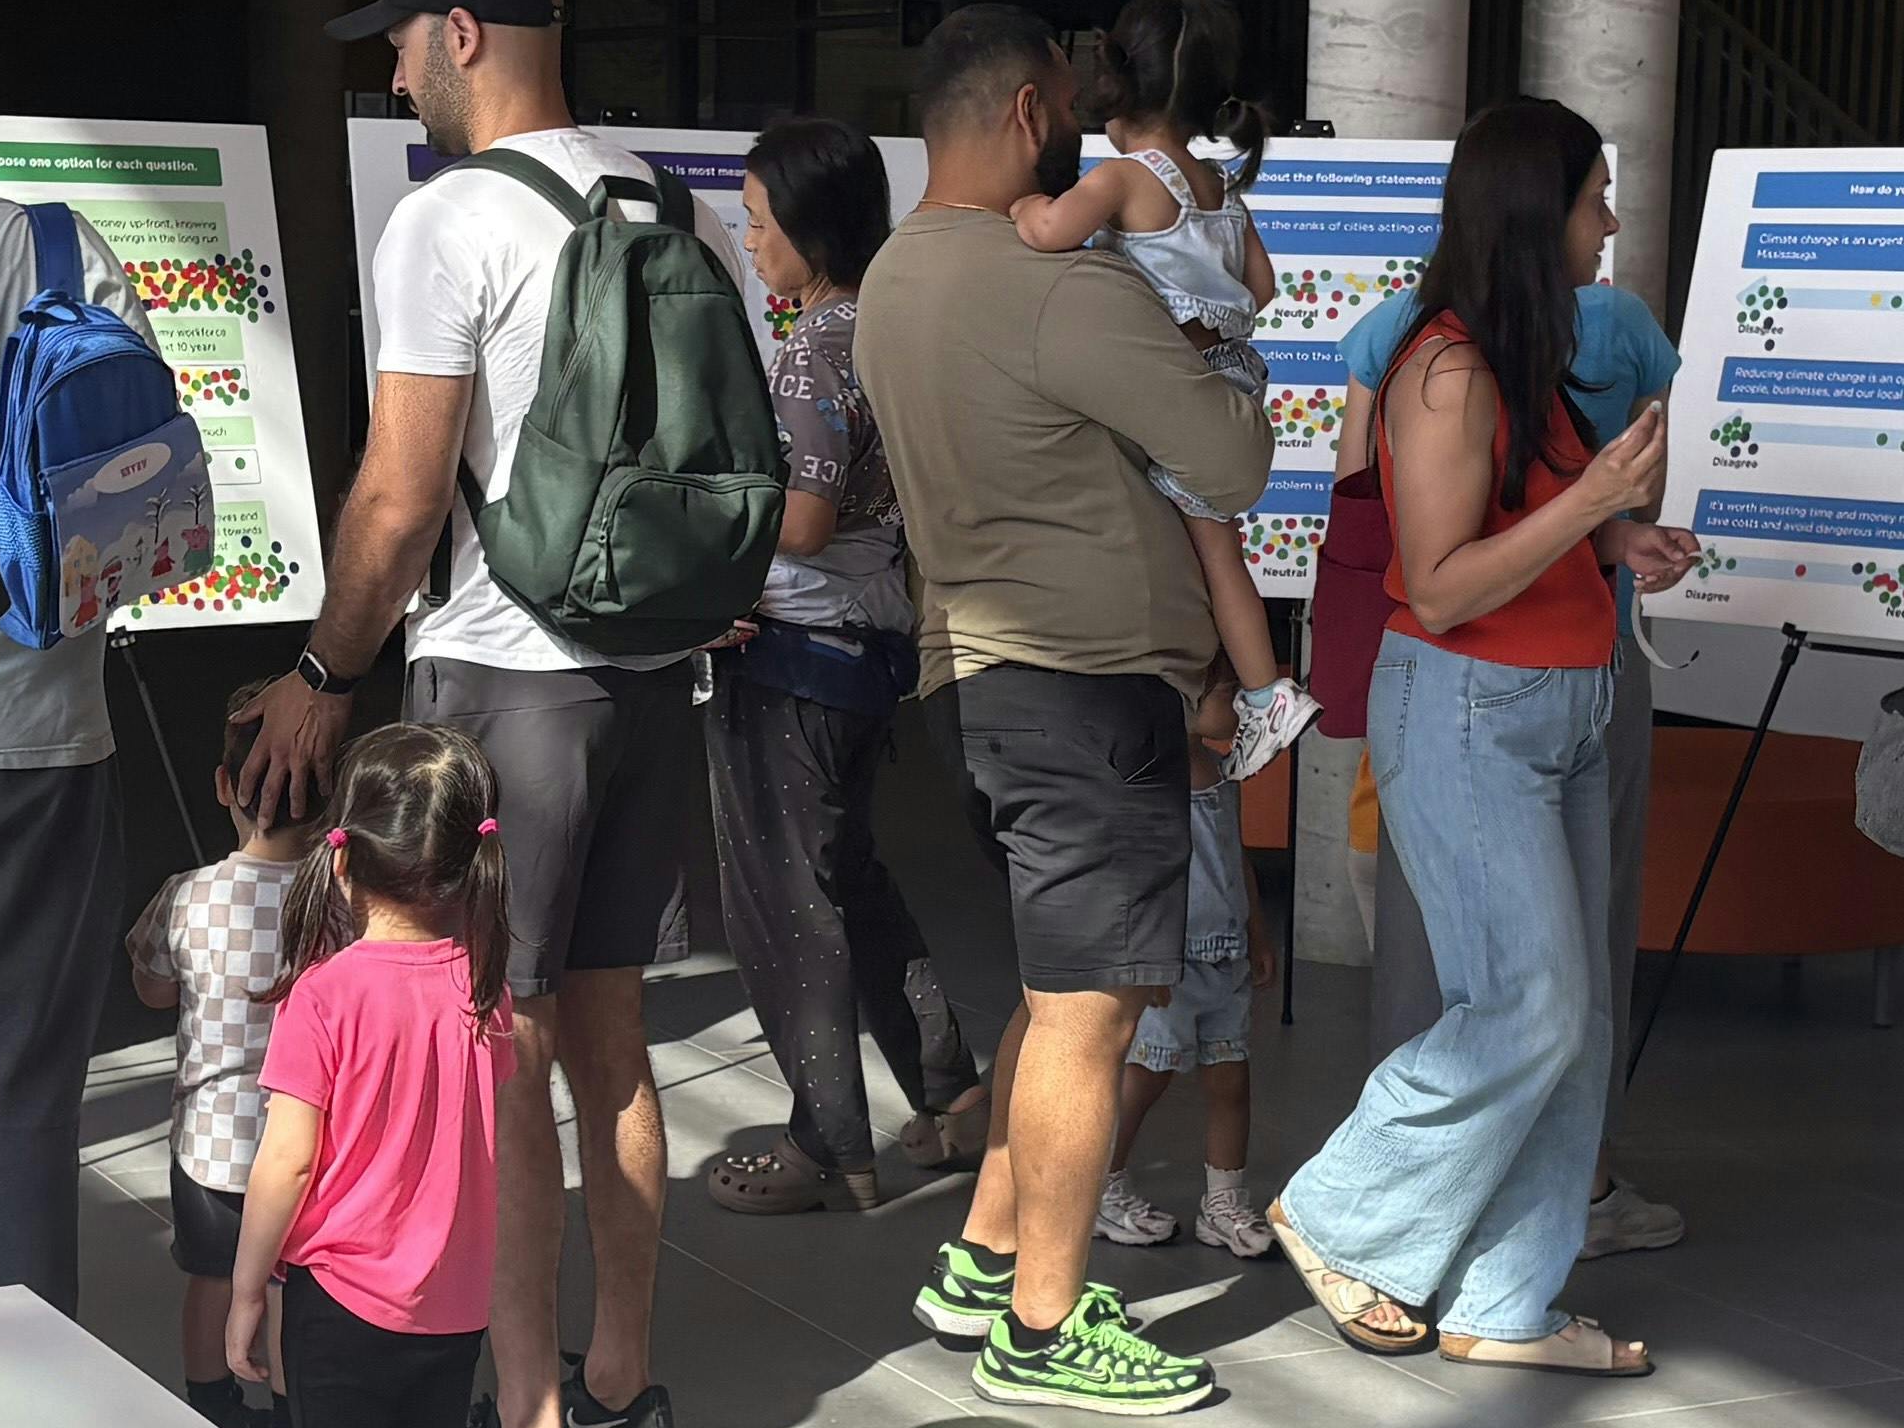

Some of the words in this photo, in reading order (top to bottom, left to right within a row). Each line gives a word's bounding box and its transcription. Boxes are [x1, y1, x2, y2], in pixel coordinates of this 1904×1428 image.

[28, 157, 51, 167] one
[54, 157, 93, 169] option
[95, 157, 112, 168] for
[115, 159, 142, 169] each
[145, 160, 197, 171] question.
[1292, 172, 1313, 182] the
[1315, 172, 1372, 185] following
[1375, 175, 1442, 184] statements
[1850, 184, 1875, 194] How
[1876, 184, 1892, 194] do
[1271, 220, 1291, 229] the
[1292, 221, 1324, 230] ranks
[1328, 221, 1341, 230] of
[1343, 222, 1374, 231] cities
[1377, 223, 1415, 233] acting
[1416, 224, 1433, 233] on
[1759, 233, 1798, 244] Climate
[1800, 235, 1839, 246] change
[1841, 236, 1849, 244] is
[1852, 236, 1866, 244] an
[1867, 236, 1903, 247] urgent
[1274, 308, 1318, 319] Neutral
[1737, 323, 1784, 338] Disagree
[1734, 366, 1783, 380] Reducing
[1785, 370, 1824, 380] climate
[1826, 372, 1866, 383] change
[1868, 374, 1876, 383] is
[1878, 375, 1893, 383] an
[1712, 454, 1758, 468] Disagree
[1262, 567, 1307, 577] Neutral
[1685, 589, 1730, 602] Disagree
